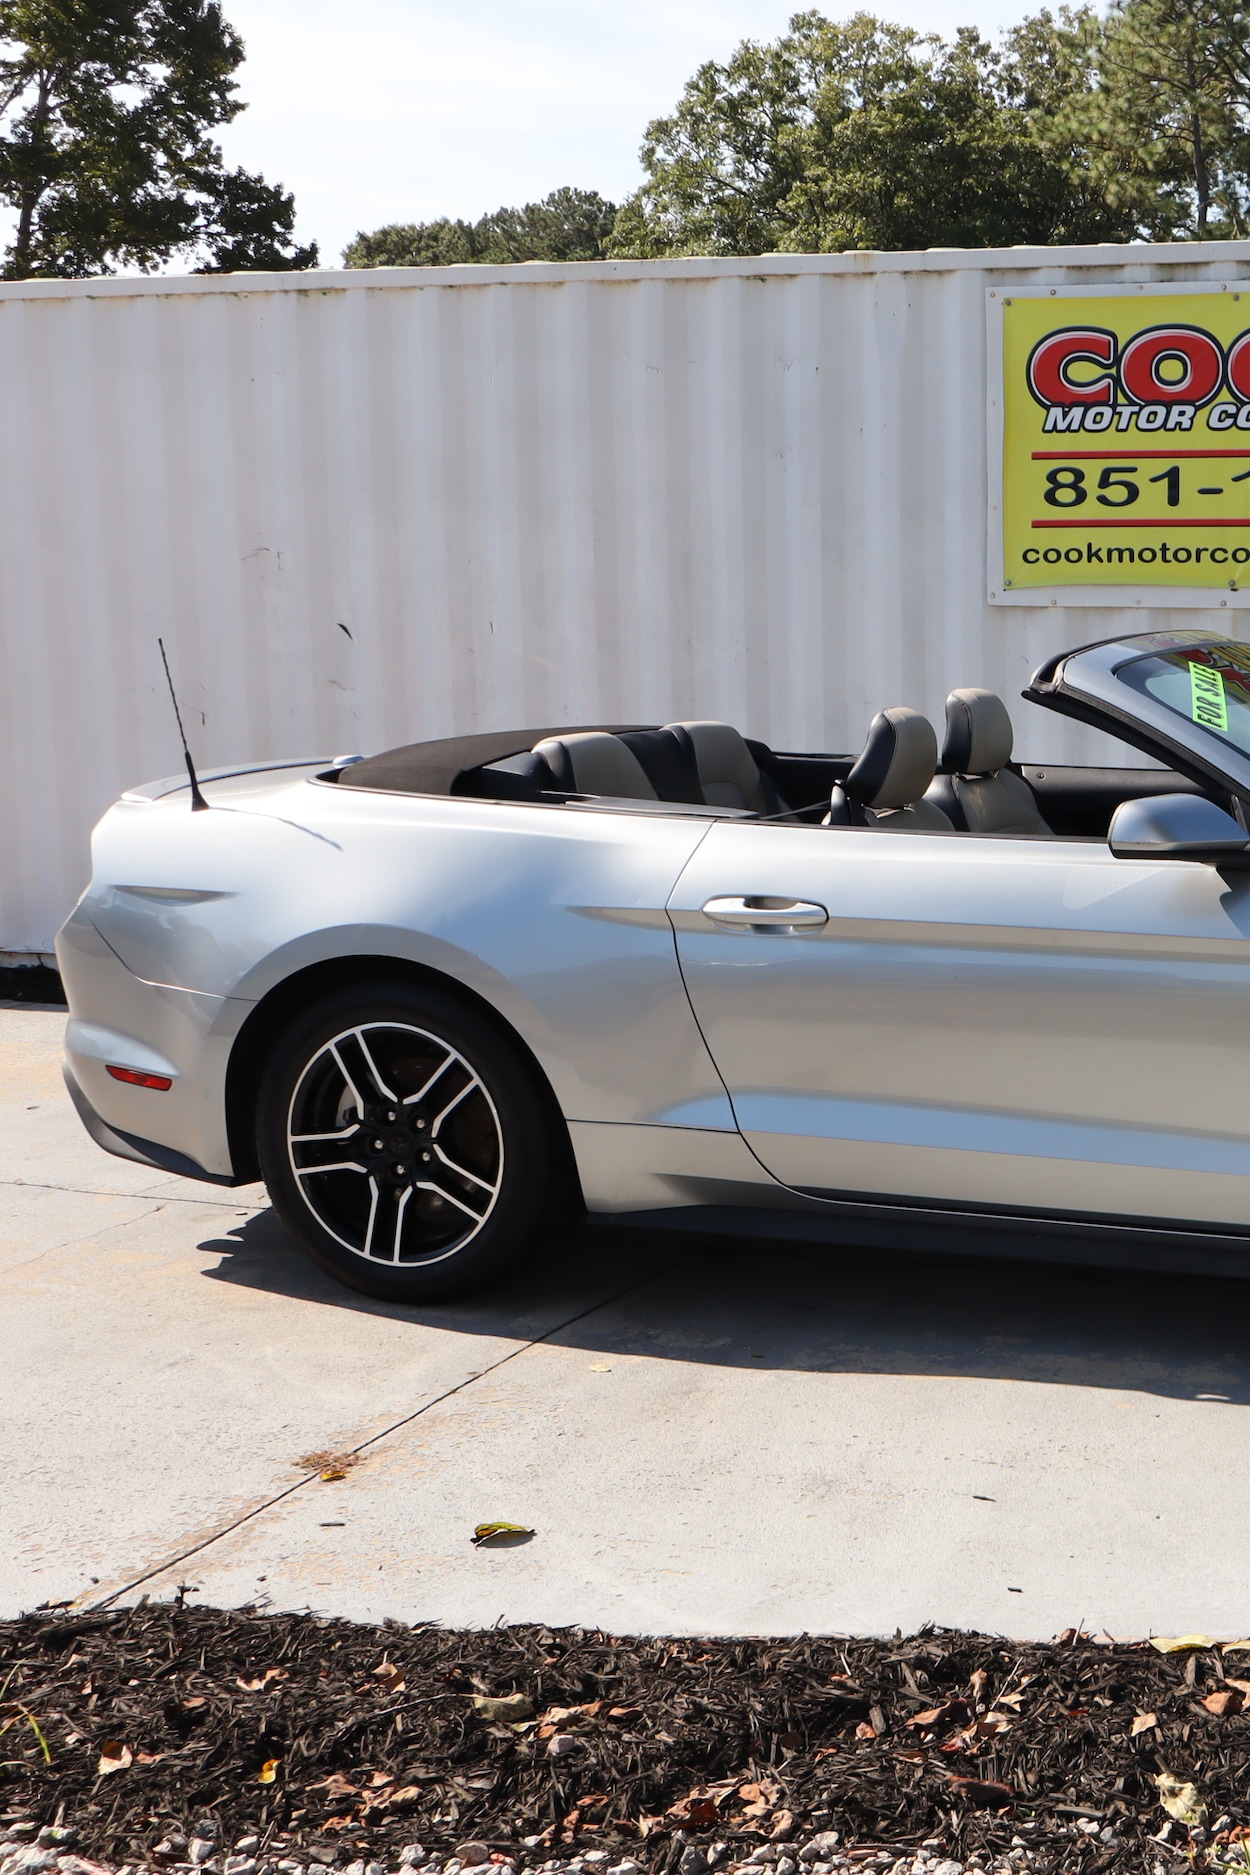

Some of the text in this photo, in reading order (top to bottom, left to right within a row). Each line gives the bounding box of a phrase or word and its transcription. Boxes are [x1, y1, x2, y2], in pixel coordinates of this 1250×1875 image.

[1042, 401, 1198, 433] MOTOR
[1192, 664, 1222, 728] FOR SALE
